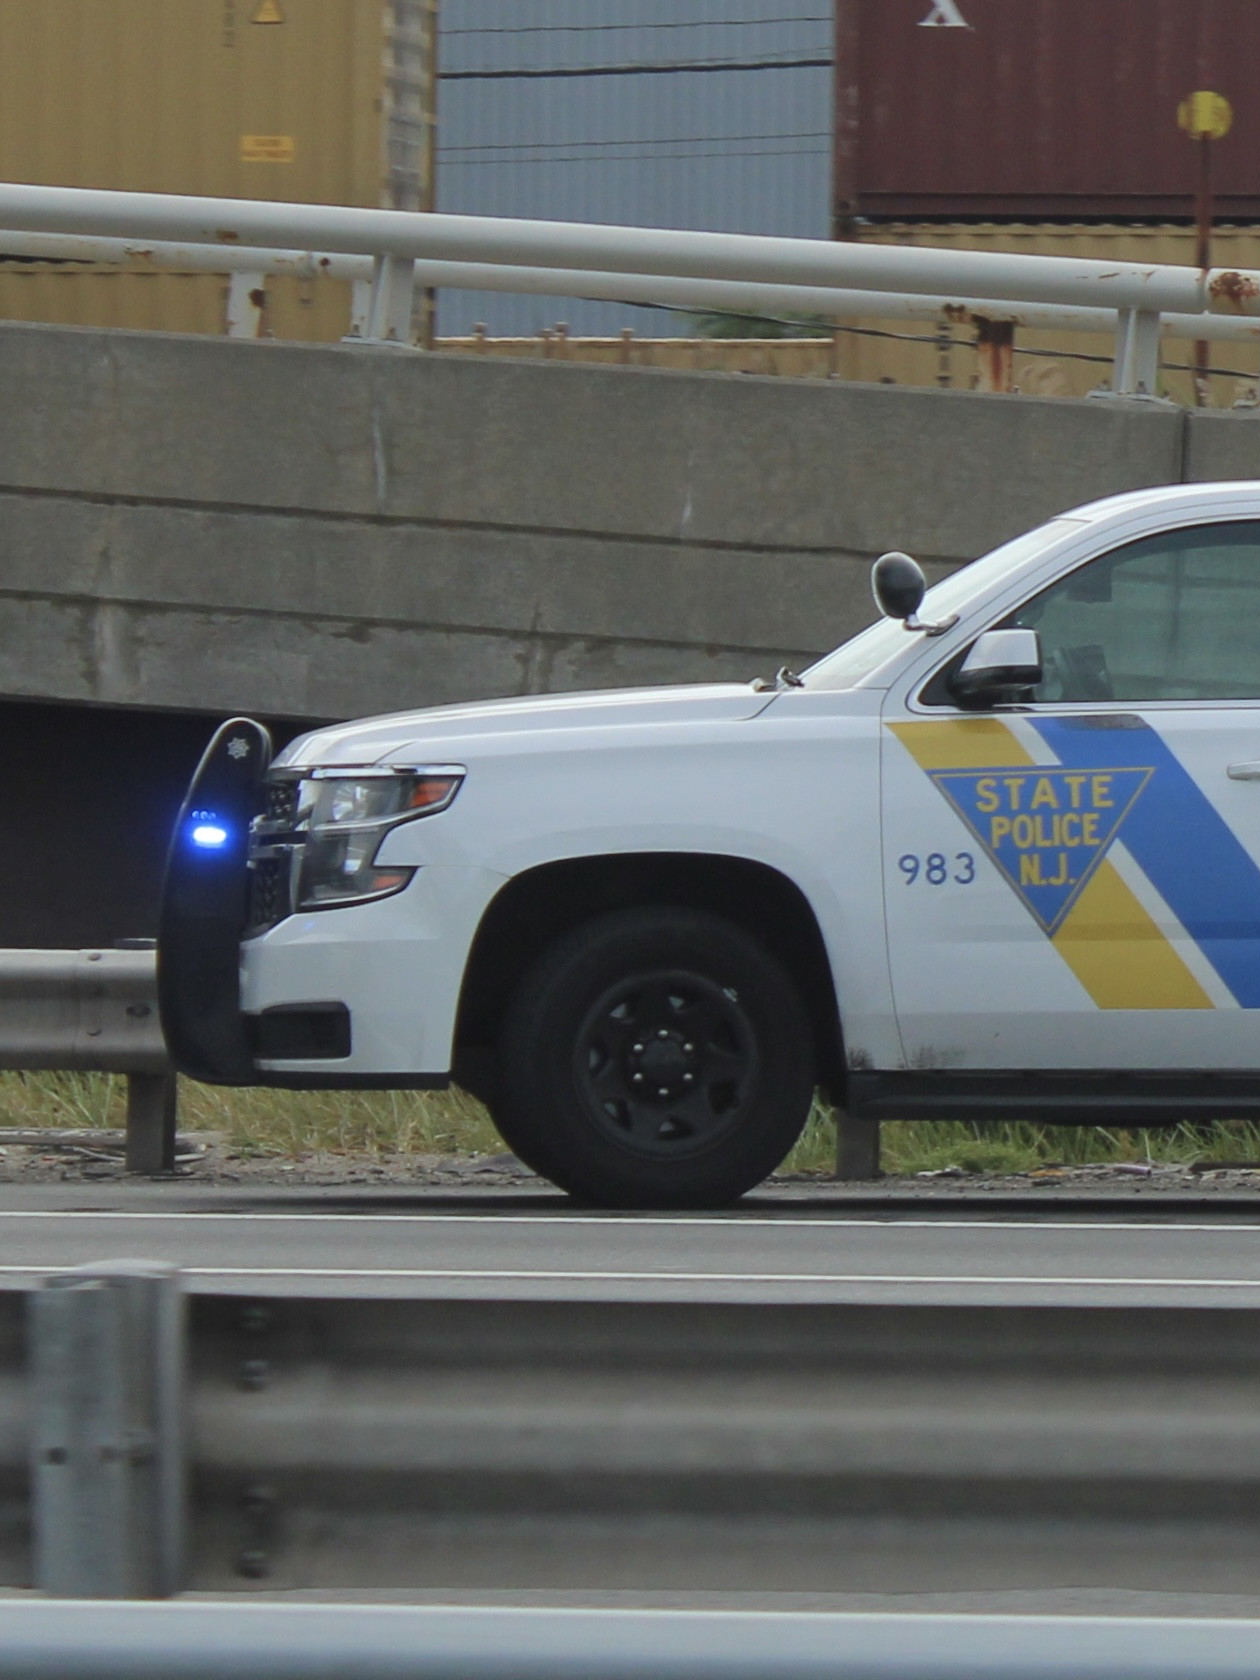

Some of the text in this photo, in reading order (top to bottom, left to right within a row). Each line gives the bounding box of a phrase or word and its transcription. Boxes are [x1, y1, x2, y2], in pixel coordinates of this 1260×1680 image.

[976, 775, 1114, 812] STATE
[991, 813, 1100, 849] POLICE
[898, 852, 976, 886] 983
[1019, 854, 1077, 887] N.J.
